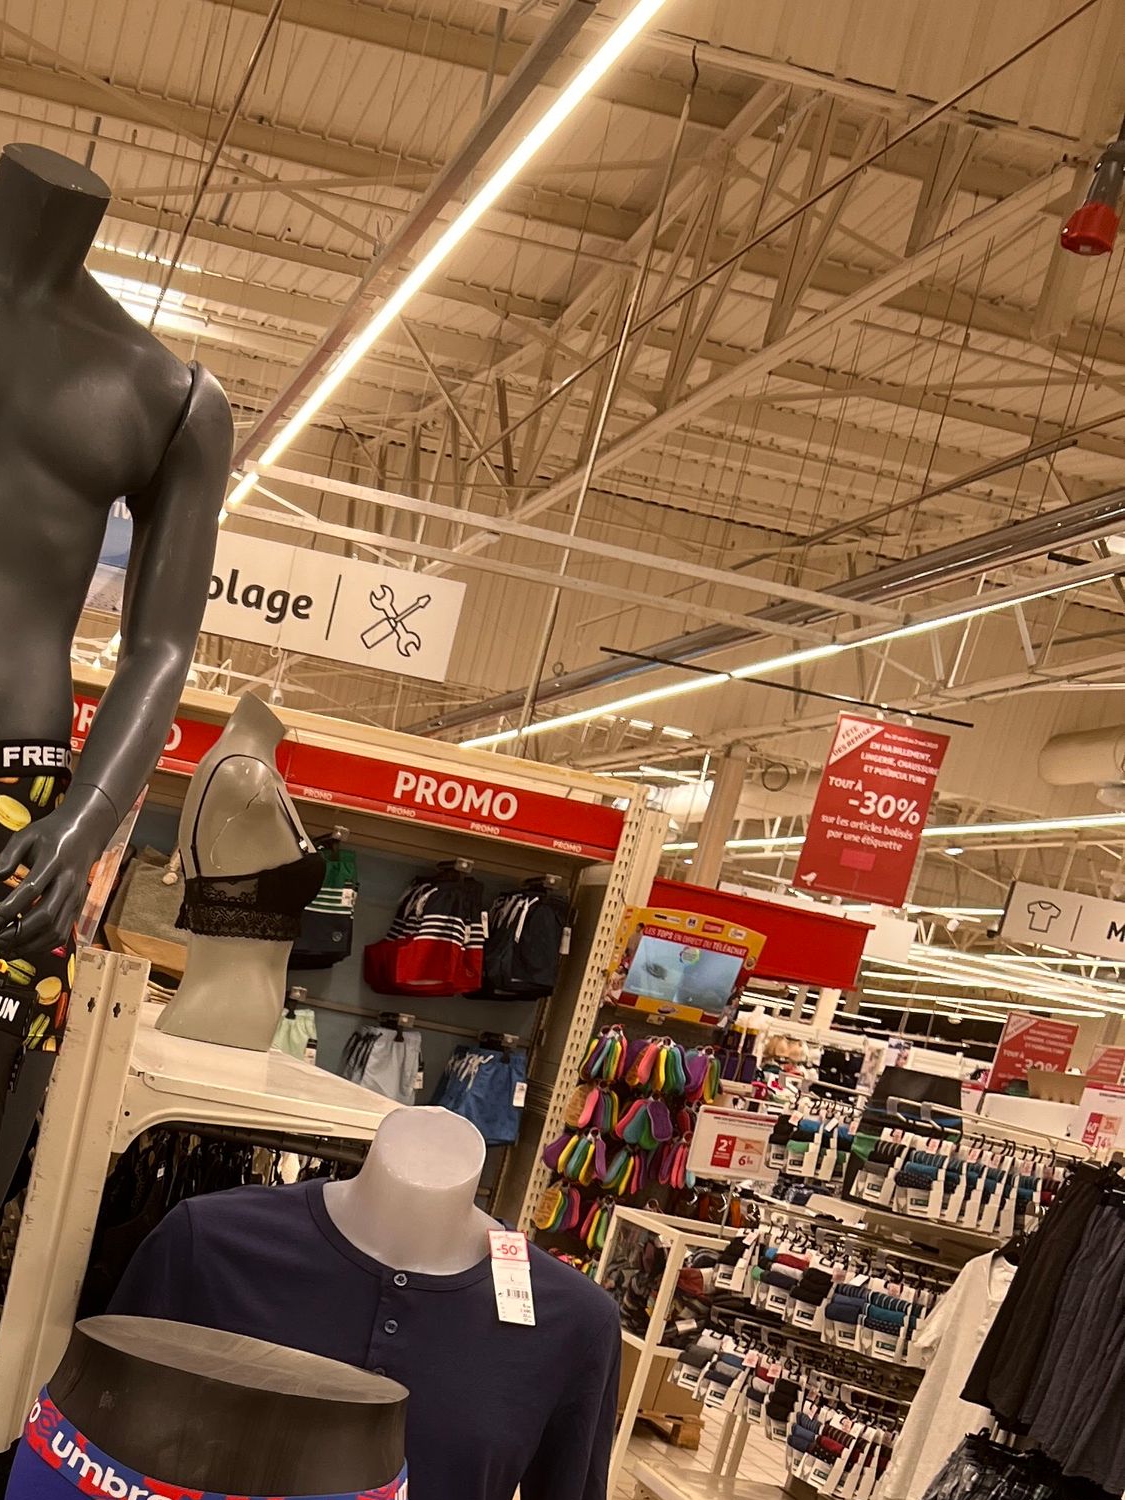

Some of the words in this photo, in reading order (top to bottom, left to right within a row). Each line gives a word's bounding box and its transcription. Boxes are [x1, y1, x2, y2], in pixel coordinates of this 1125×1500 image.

[828, 775, 855, 790] TOUT
[854, 779, 863, 792] À
[393, 769, 518, 821] PROMO
[848, 790, 921, 825] -30%
[303, 787, 333, 801] PROMO
[386, 804, 416, 818] PROMO
[470, 822, 500, 836] PROMO
[552, 839, 582, 853] PROMO
[821, 814, 836, 824] sur
[836, 815, 849, 827] les
[849, 820, 883, 834] articles
[826, 829, 844, 840] par
[843, 832, 861, 843] une
[656, 928, 674, 940] TOPS
